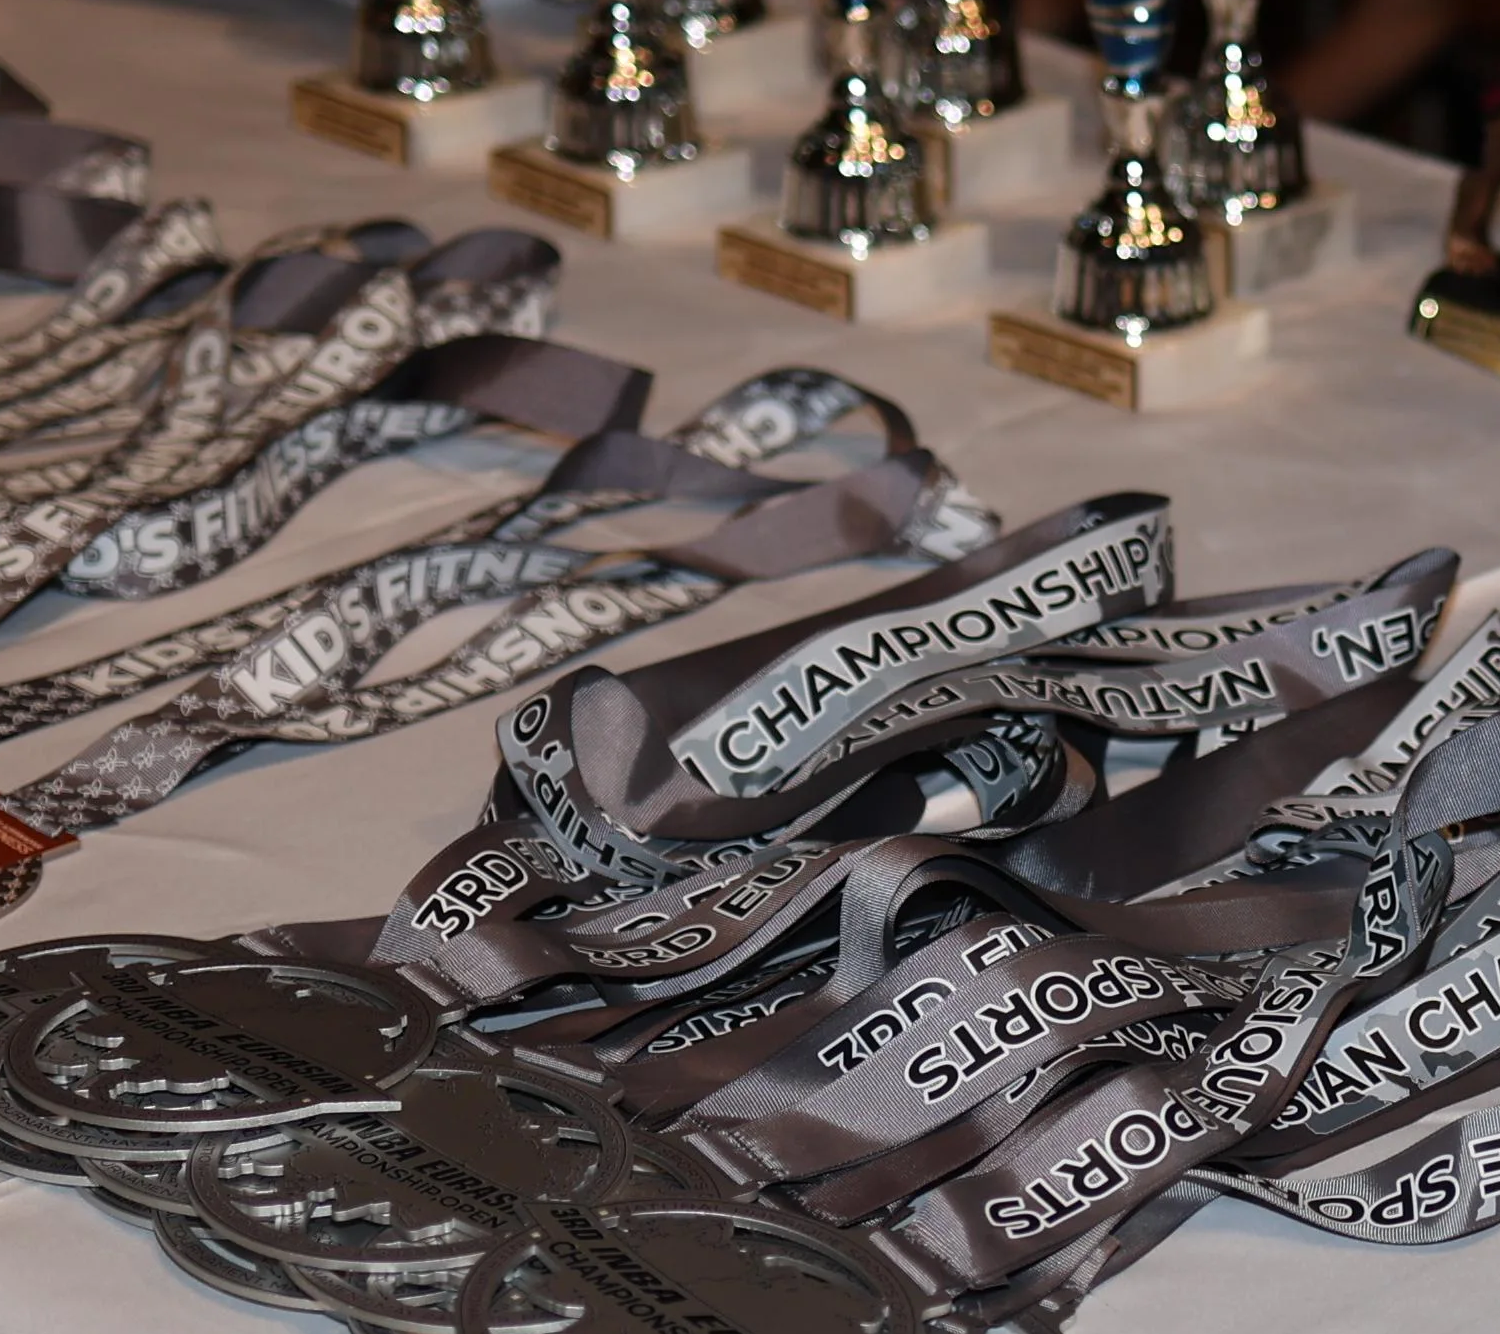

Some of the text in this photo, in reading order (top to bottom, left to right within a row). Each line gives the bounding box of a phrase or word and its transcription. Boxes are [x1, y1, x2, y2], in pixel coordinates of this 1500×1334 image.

[64, 409, 345, 581] D'S FITNESS
[232, 545, 574, 717] KID'S FITNE
[963, 657, 1277, 725] NATURAL
[413, 847, 531, 944] 3RD
[102, 971, 360, 1096] 3RD INBA EURASIAN
[903, 955, 1166, 1106] SPORTS
[1270, 1029, 1412, 1130] SIAN
[983, 943, 1345, 1240] HYSIQUE PORTS
[337, 1113, 520, 1215] INBA EURAS
[1258, 1154, 1460, 1229] SPO
[550, 1207, 603, 1242] 3RD
[589, 1246, 689, 1305] INBA
